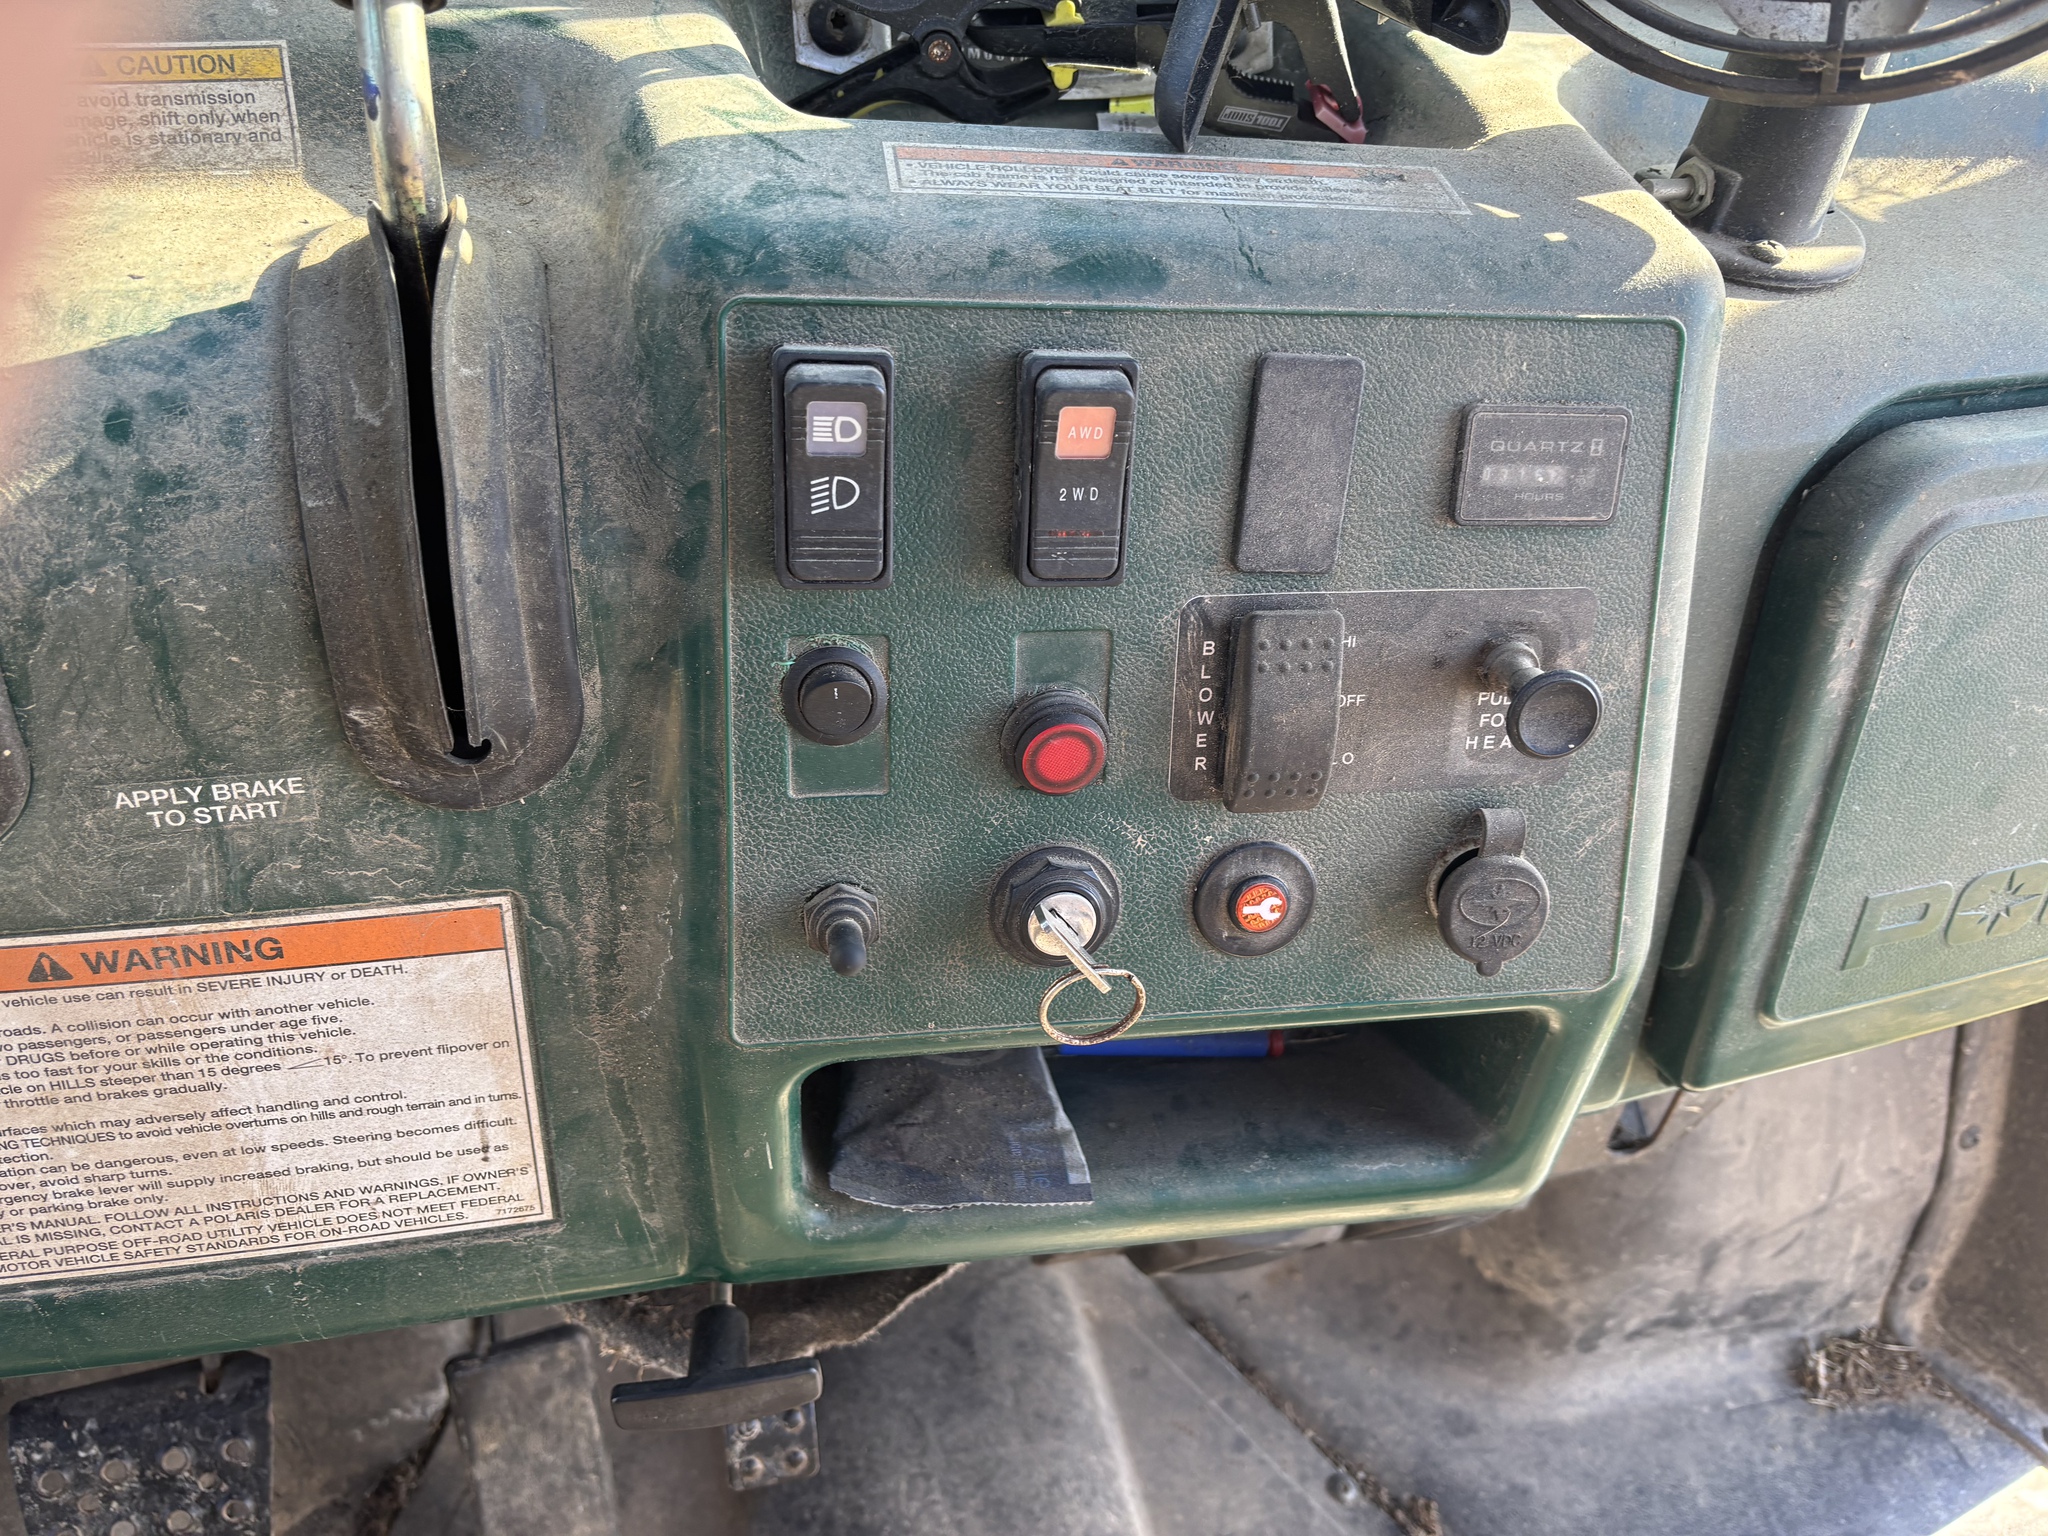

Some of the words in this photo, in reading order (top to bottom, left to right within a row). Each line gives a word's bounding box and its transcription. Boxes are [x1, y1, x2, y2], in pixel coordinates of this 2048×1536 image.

[116, 54, 236, 75] CAUTION
[77, 92, 129, 107] avoid
[136, 90, 255, 106] transmission
[139, 111, 180, 125] shift
[187, 110, 225, 128] only
[233, 110, 281, 123] when
[1222, 110, 1255, 123] SHOP
[1256, 114, 1284, 128] TOOL
[128, 134, 143, 145] is
[149, 131, 242, 147] stationary
[249, 128, 282, 142] and
[918, 162, 986, 172] VEHICLE
[990, 164, 1075, 174] ROLLOVER
[1080, 168, 1119, 177] could
[1131, 158, 1238, 171] WARNING
[919, 169, 949, 177] The
[1079, 175, 1146, 185] designed
[1170, 179, 1233, 188] intended
[921, 179, 987, 188] ALWAYS
[990, 181, 1040, 189] WEAR
[1044, 183, 1091, 192] YOUR
[1095, 185, 1133, 193] SEAT
[1138, 187, 1176, 195] BELT
[1180, 188, 1200, 196] for
[1067, 426, 1104, 440] AWD
[1490, 440, 1584, 453] QUARTZ
[1514, 492, 1565, 502] HOURS
[1194, 640, 1216, 771] BLOWER
[1477, 691, 1512, 706] PUL
[1479, 712, 1505, 728] FO
[1465, 734, 1512, 750] HEA
[114, 786, 203, 810] APPLY
[211, 777, 305, 801] BRAKE
[146, 809, 186, 828] TO
[193, 800, 281, 825] START
[1490, 934, 1522, 948] VDC
[79, 936, 285, 976] WARNING
[1, 995, 58, 1008] vehicle
[62, 994, 91, 1003] use
[96, 991, 125, 1001] can
[129, 985, 175, 998] result
[177, 984, 192, 994] in
[196, 977, 263, 992] SEVERE
[266, 971, 325, 986] INJURY
[331, 972, 346, 980] or
[350, 964, 408, 979] DEATH.
[51, 1023, 63, 1034] A
[67, 1019, 132, 1032] collision
[136, 1017, 165, 1027] can
[169, 1012, 214, 1024] occur
[217, 1008, 251, 1020] with
[255, 1003, 314, 1016] another
[317, 997, 375, 1010] vehicle.
[17, 1036, 111, 1053] passengers,
[115, 1034, 132, 1043] or
[136, 1026, 226, 1043] passengers
[230, 1021, 276, 1033] under
[279, 1019, 307, 1030] age
[311, 1015, 343, 1025] five.
[5, 1052, 66, 1066] DRUGS
[69, 1049, 120, 1061] before
[124, 1048, 141, 1056] or
[144, 1042, 185, 1054] while
[189, 1036, 263, 1052] operating
[267, 1032, 295, 1043] this
[298, 1027, 356, 1040] vehicle.
[13, 1070, 40, 1079] too
[43, 1066, 74, 1077] fast
[77, 1064, 99, 1074] for
[102, 1062, 138, 1075] your
[142, 1057, 181, 1069] skills
[185, 1056, 201, 1065] or
[204, 1053, 230, 1063] the
[234, 1046, 318, 1061] conditions.
[26, 1084, 46, 1093] on
[49, 1078, 96, 1091] HILLS
[99, 1075, 157, 1087] steeper
[160, 1071, 195, 1081] than
[198, 1067, 217, 1078] 15
[221, 1063, 281, 1076] degrees
[354, 1052, 375, 1062] To
[379, 1046, 434, 1063] prevent
[436, 1042, 489, 1055] flipover
[492, 1040, 510, 1049] on
[3, 1095, 59, 1109] throttle
[63, 1092, 92, 1104] and
[96, 1089, 149, 1101] brakes
[153, 1081, 228, 1098] gradually.
[51, 1120, 96, 1132] which
[100, 1119, 131, 1129] may
[135, 1110, 206, 1125] adversely
[210, 1106, 253, 1118] affect
[256, 1100, 319, 1113] handling
[323, 1095, 350, 1107] and
[354, 1090, 407, 1103] control.
[30, 1216, 101, 1230] MANUAL.
[104, 1208, 169, 1223] FOLLOW
[174, 1205, 203, 1216] ALL
[206, 1191, 320, 1212] INSTRUCTIONS
[323, 1188, 355, 1200] AND
[358, 1177, 444, 1195] WARNINGS.
[447, 1175, 459, 1184] IF
[463, 1166, 529, 1183] OWNER'S
[34, 1228, 106, 1242] MISSING,
[109, 1219, 184, 1235] CONTACT
[203, 1209, 271, 1225] POLARIS
[274, 1202, 335, 1217] DEALER
[339, 1198, 371, 1210] FOR
[373, 1197, 386, 1205] A
[388, 1183, 501, 1203] REPLACEMENT.
[43, 1241, 119, 1256] PURPOSE
[122, 1232, 203, 1248] OFF-ROAD
[206, 1225, 263, 1239] UTILITY
[267, 1217, 333, 1233] VEHICLE
[336, 1207, 380, 1224] DOES
[382, 1207, 413, 1219] NOT
[416, 1201, 456, 1214] MEET
[460, 1193, 525, 1209] FEDERAL
[54, 1252, 121, 1268] VEHICLE
[123, 1245, 181, 1260] SAFETY
[185, 1235, 280, 1253] STANDARDS
[284, 1231, 316, 1242] FOR
[319, 1221, 390, 1237] ON-ROAD
[393, 1213, 469, 1228] VEHICLES.
